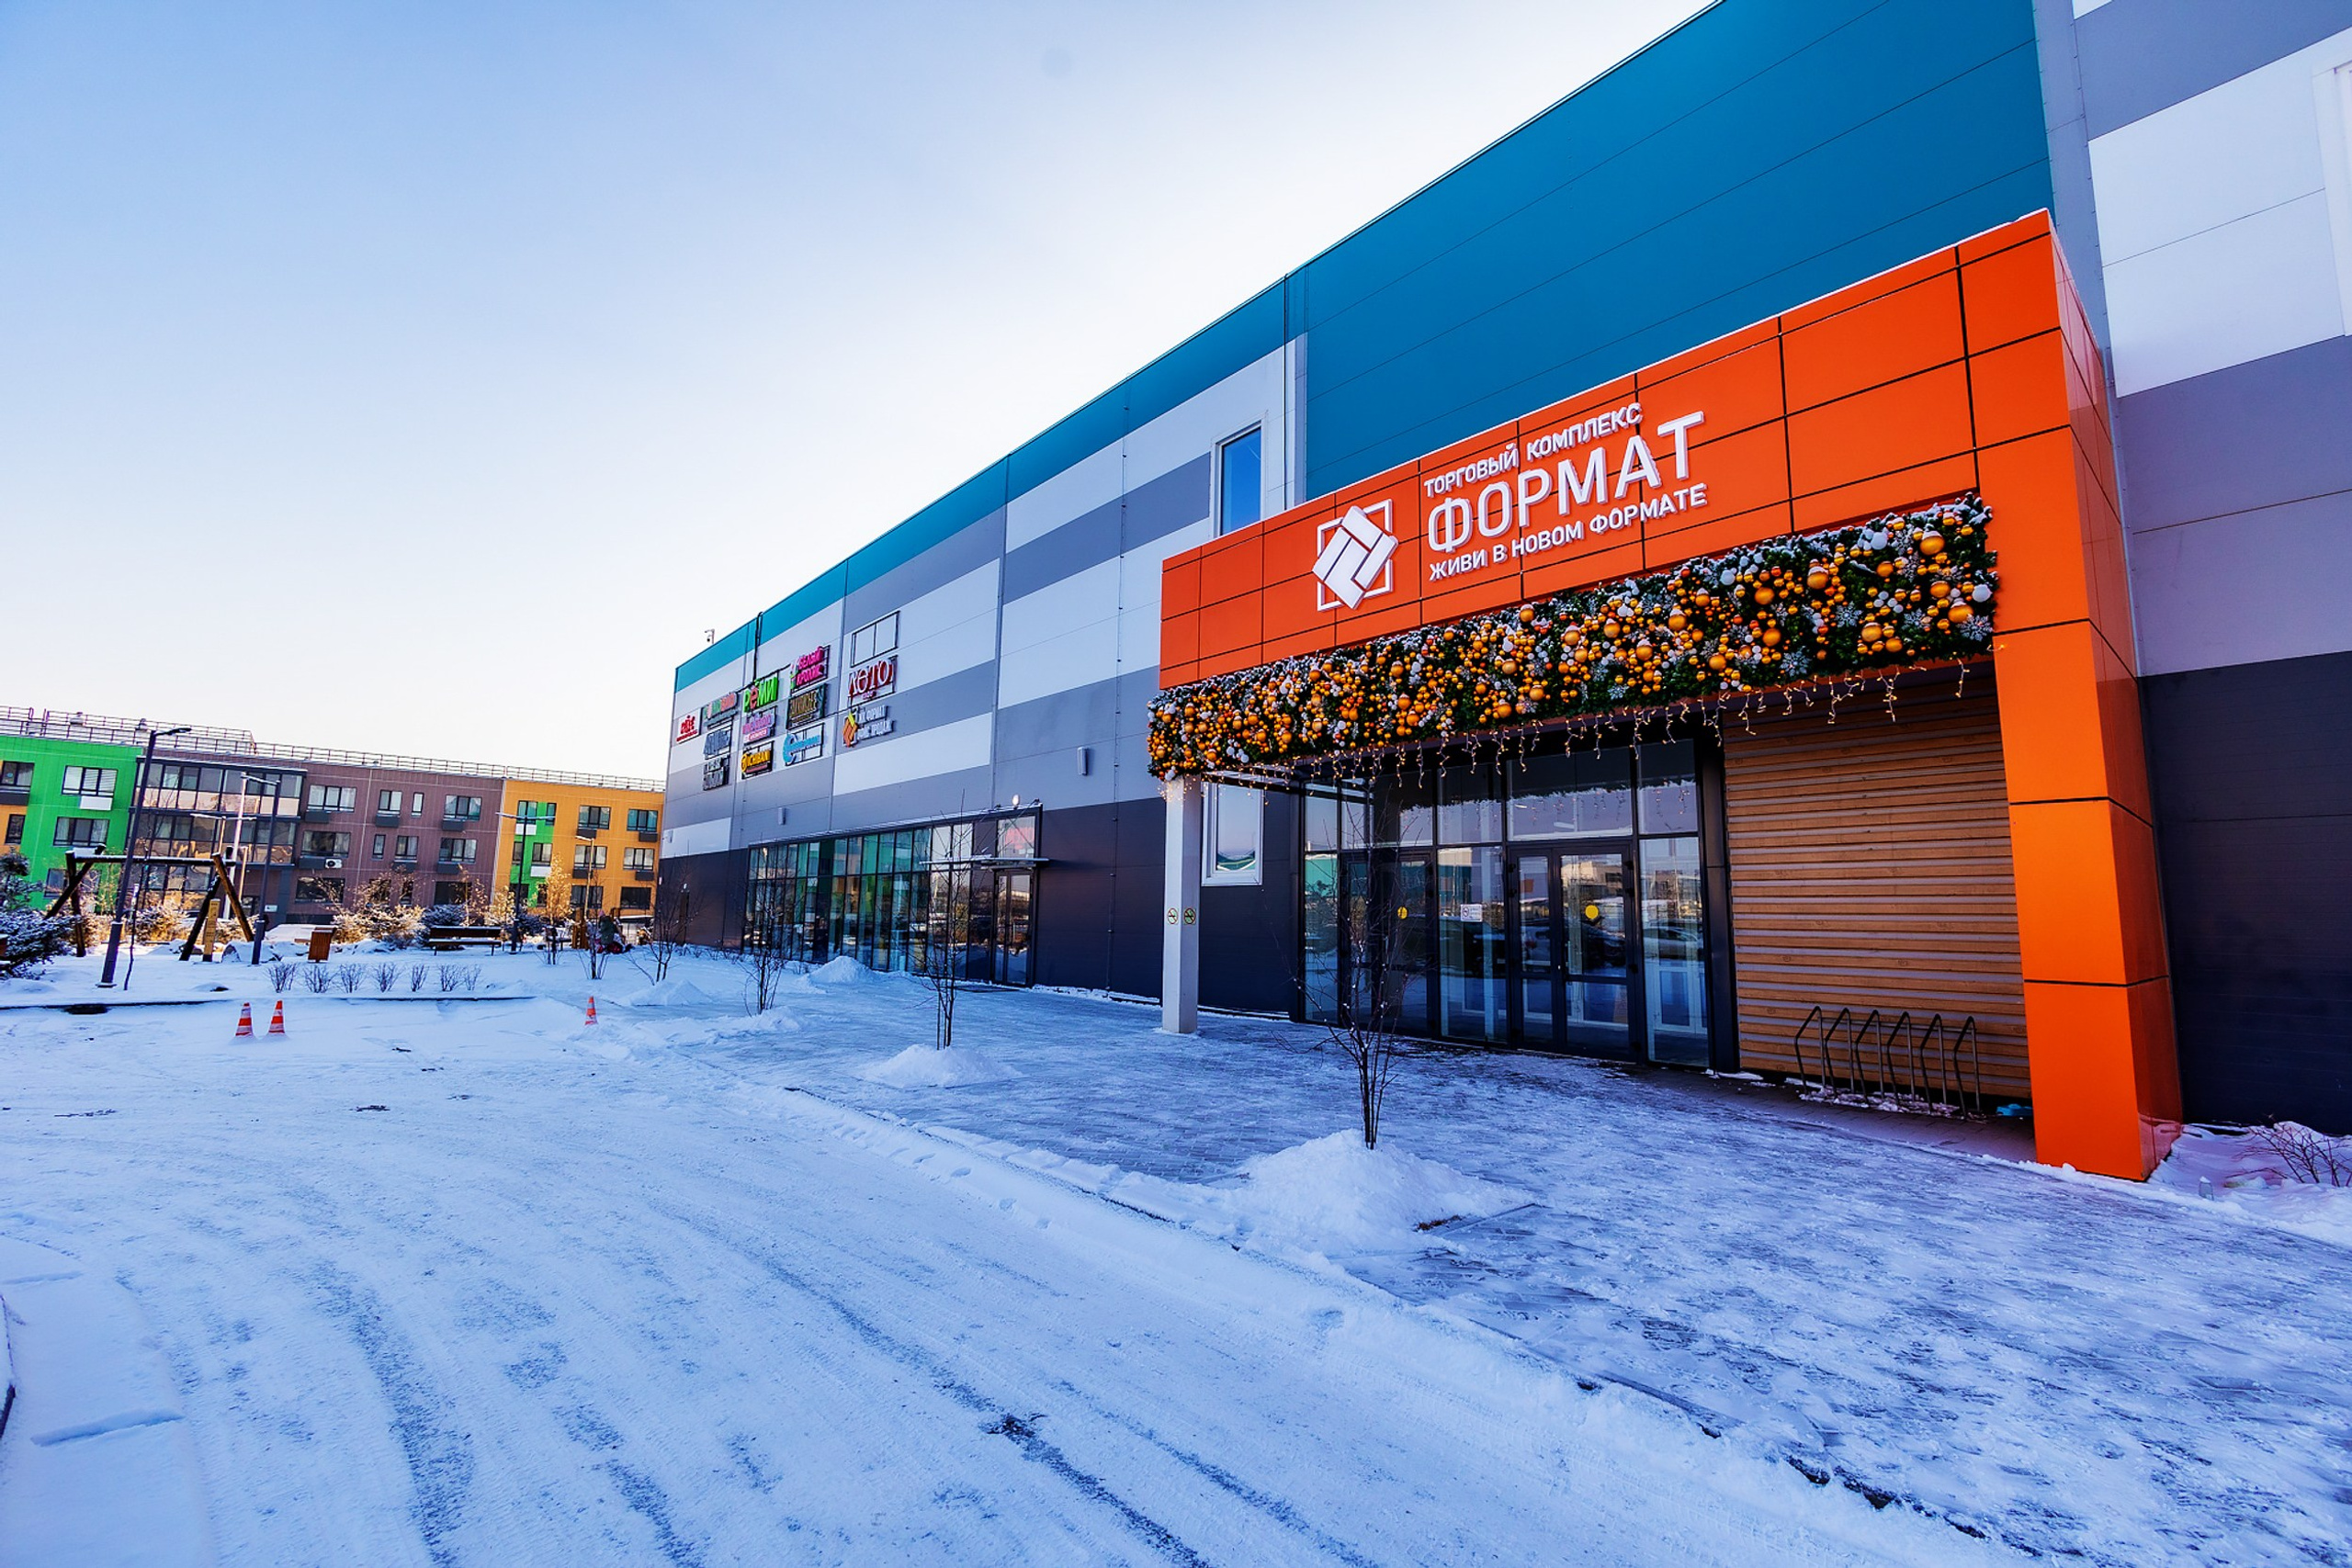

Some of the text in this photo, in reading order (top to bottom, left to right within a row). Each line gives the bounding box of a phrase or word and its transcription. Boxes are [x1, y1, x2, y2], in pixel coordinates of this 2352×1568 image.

[1424, 402, 1644, 498] ТОРГОВЫЙ КОМПЛЕКС
[1428, 410, 1706, 553] ФОРМАТ
[1429, 482, 1708, 581] ЖИВИ В НОВОМ ФОРМАТЕ
